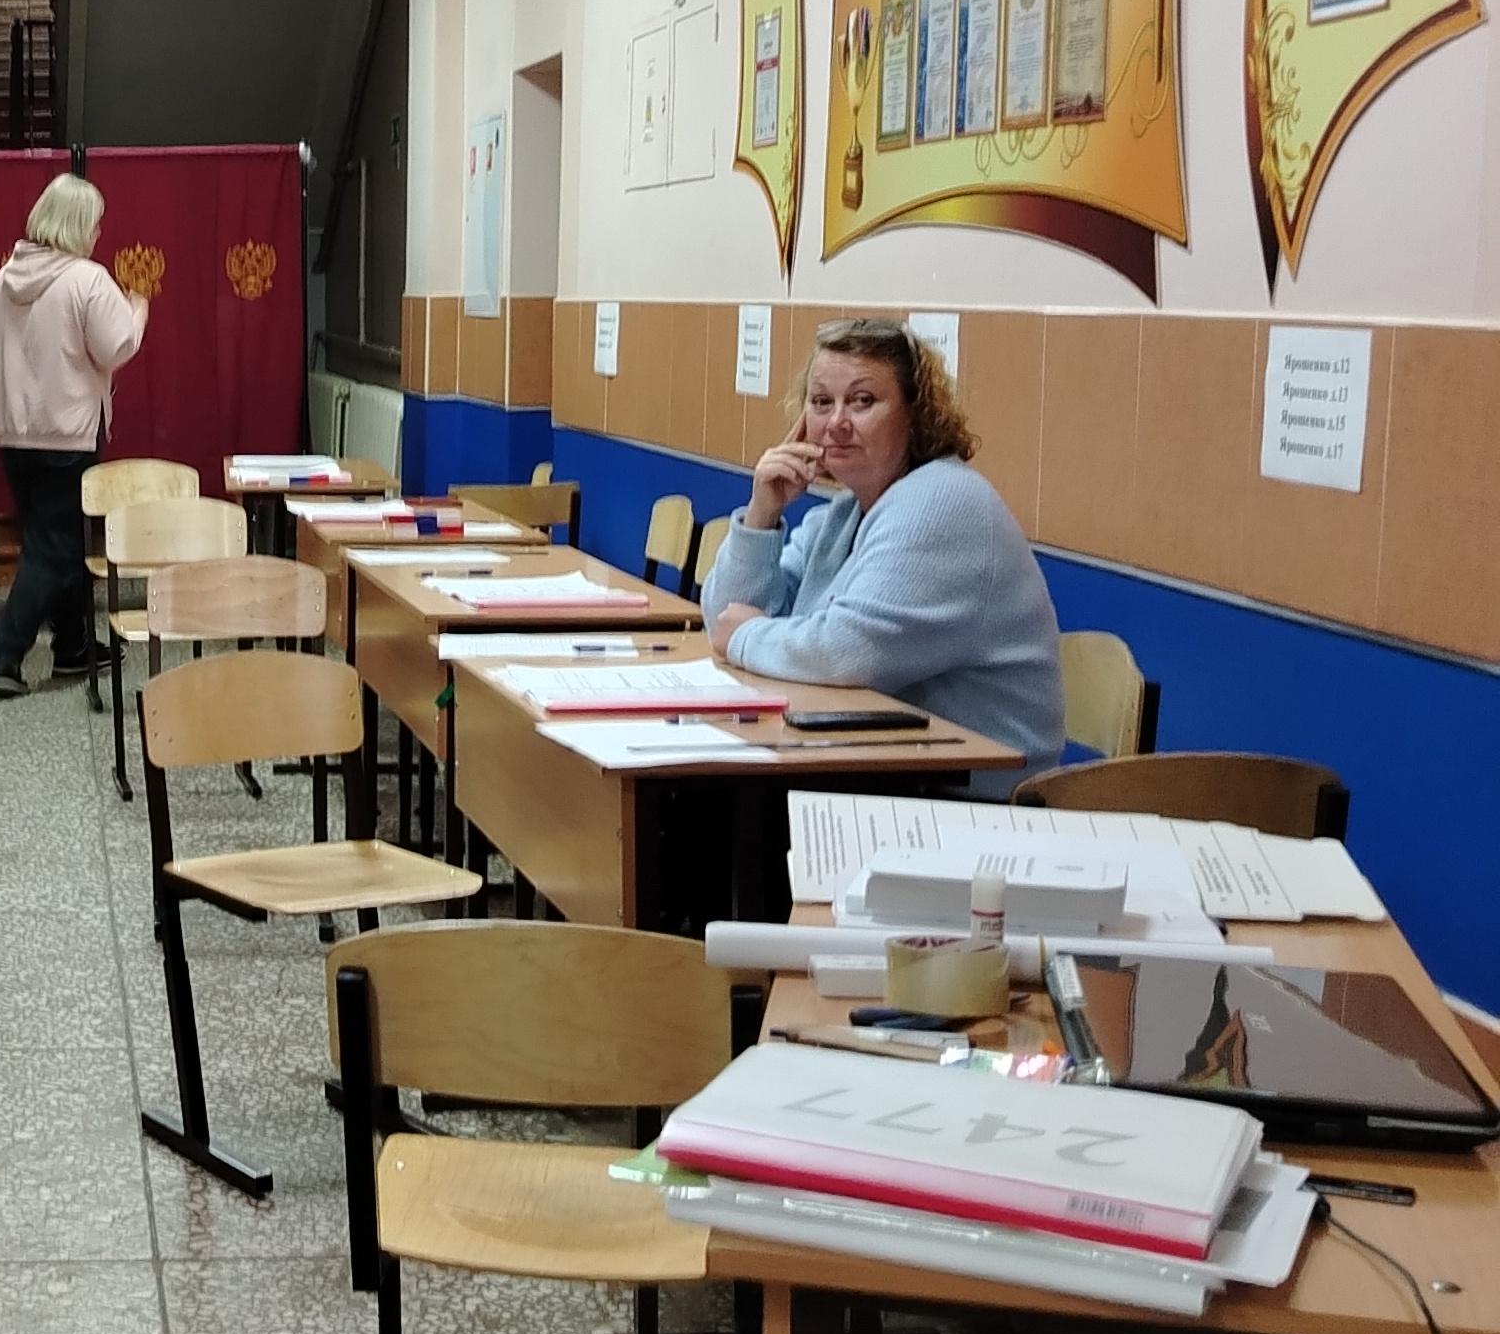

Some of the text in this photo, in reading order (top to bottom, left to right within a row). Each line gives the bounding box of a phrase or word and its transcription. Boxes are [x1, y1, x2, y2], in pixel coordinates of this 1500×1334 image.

[1283, 353, 1330, 375] Ярошенко
[1281, 381, 1328, 403] Ярошенко
[1280, 409, 1326, 430] Ярошенко
[1279, 436, 1324, 458] Ярошенко
[780, 1087, 1139, 1168] 2477
